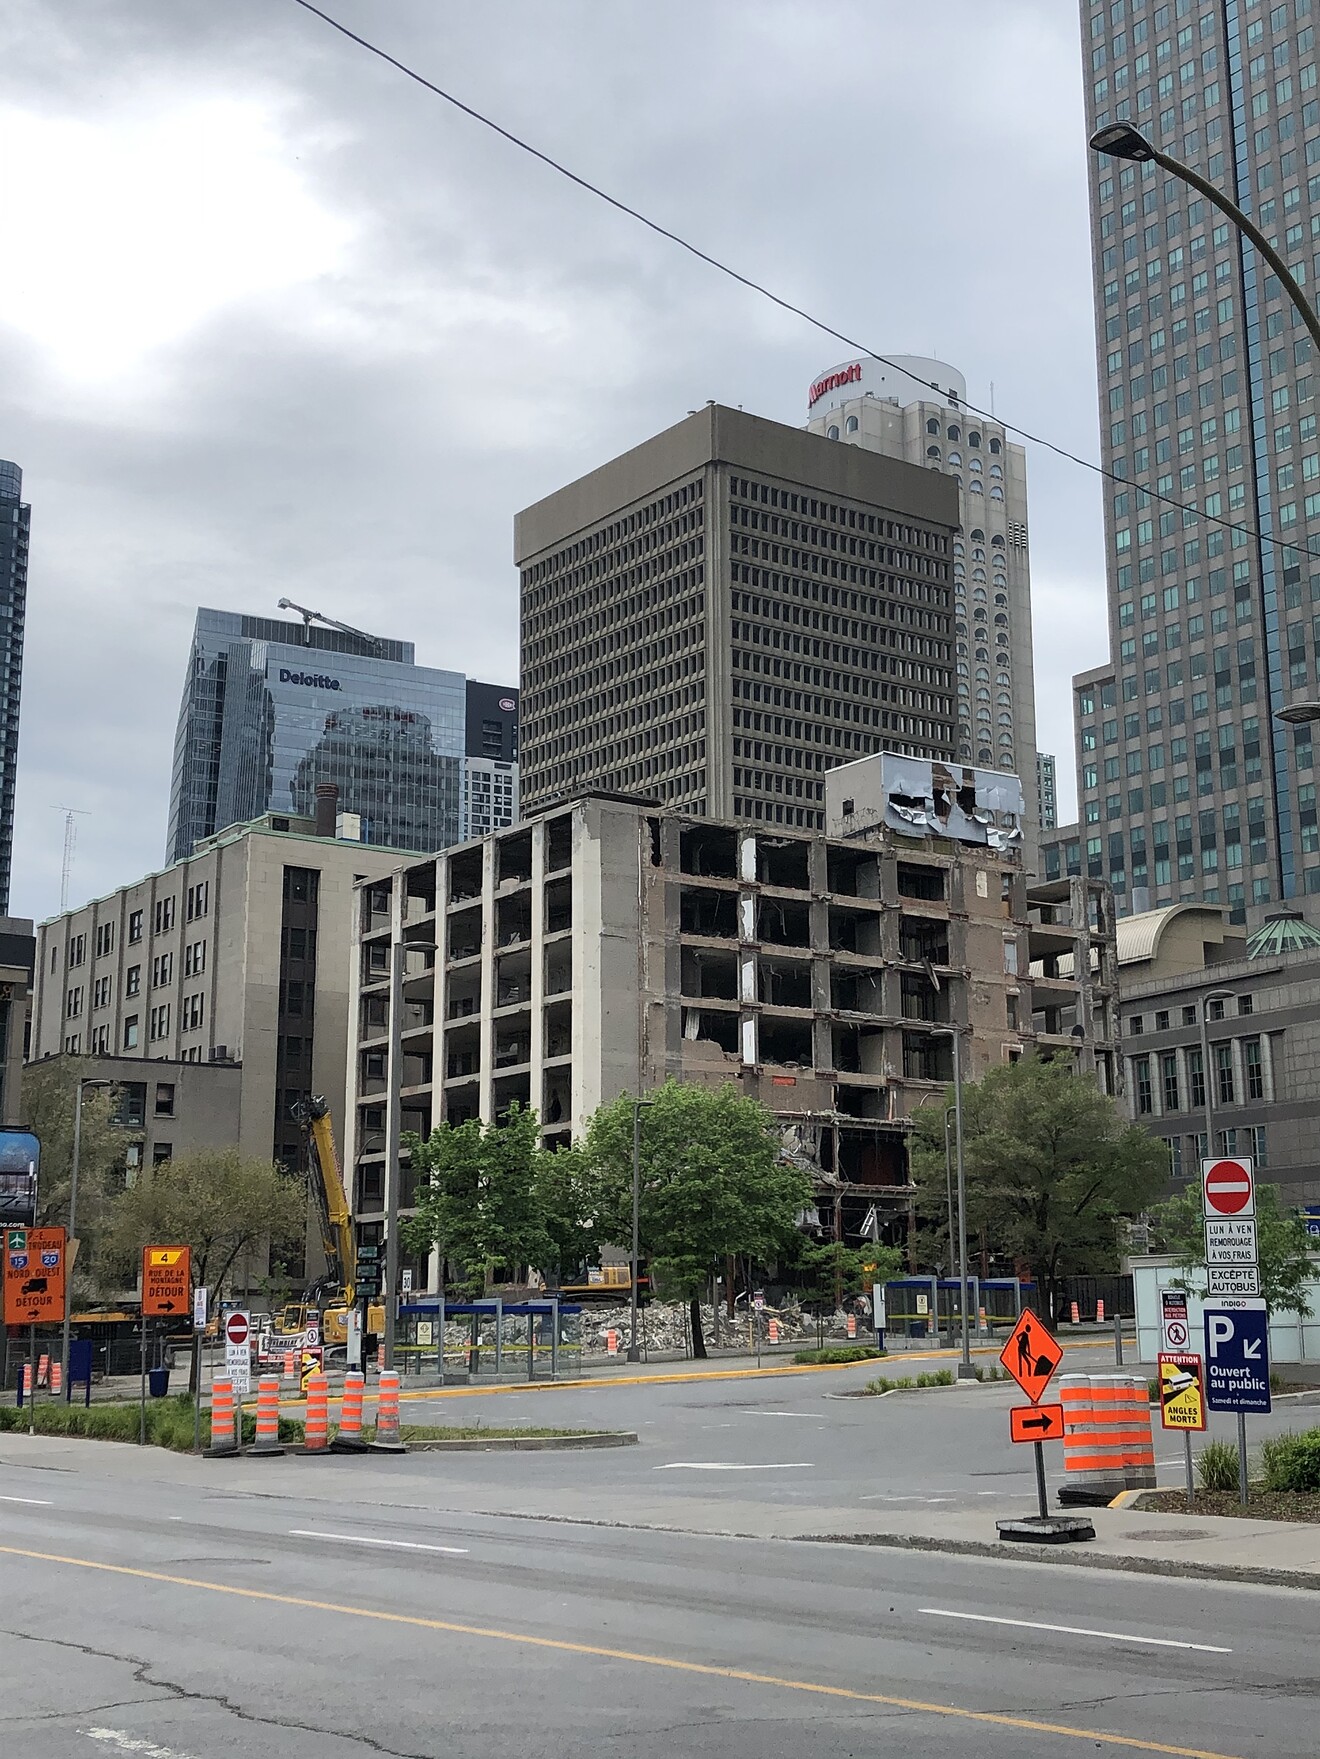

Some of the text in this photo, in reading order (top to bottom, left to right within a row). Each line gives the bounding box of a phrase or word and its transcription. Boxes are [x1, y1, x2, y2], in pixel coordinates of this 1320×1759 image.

[808, 363, 862, 408] Marriott
[1209, 1224, 1224, 1235] LUN
[1236, 1224, 1252, 1235] VEN
[1209, 1237, 1253, 1247] REMORQUAGE
[160, 1253, 169, 1263] 4
[1217, 1250, 1232, 1260] VOS
[1232, 1250, 1252, 1260] FRAIS
[14, 1256, 57, 1266] 15 20
[7, 1267, 60, 1279] NORD OUEST
[164, 1269, 174, 1277] DE
[176, 1269, 185, 1277] LA
[1211, 1268, 1255, 1280] EXCEPTÉ
[404, 1277, 410, 1289] 30
[1211, 1282, 1257, 1292] AUTOBUS
[149, 1285, 184, 1297] DÉTOUR
[1221, 1300, 1247, 1308] INDIGO
[1208, 1315, 1235, 1358] P
[1160, 1355, 1199, 1364] ATTENTION
[1209, 1365, 1251, 1378] Ouvert
[1210, 1378, 1266, 1392] au public
[1211, 1397, 1267, 1407] Samedi et dimanche
[1168, 1406, 1198, 1416] ANGLES
[1169, 1415, 1197, 1424] MORTS
